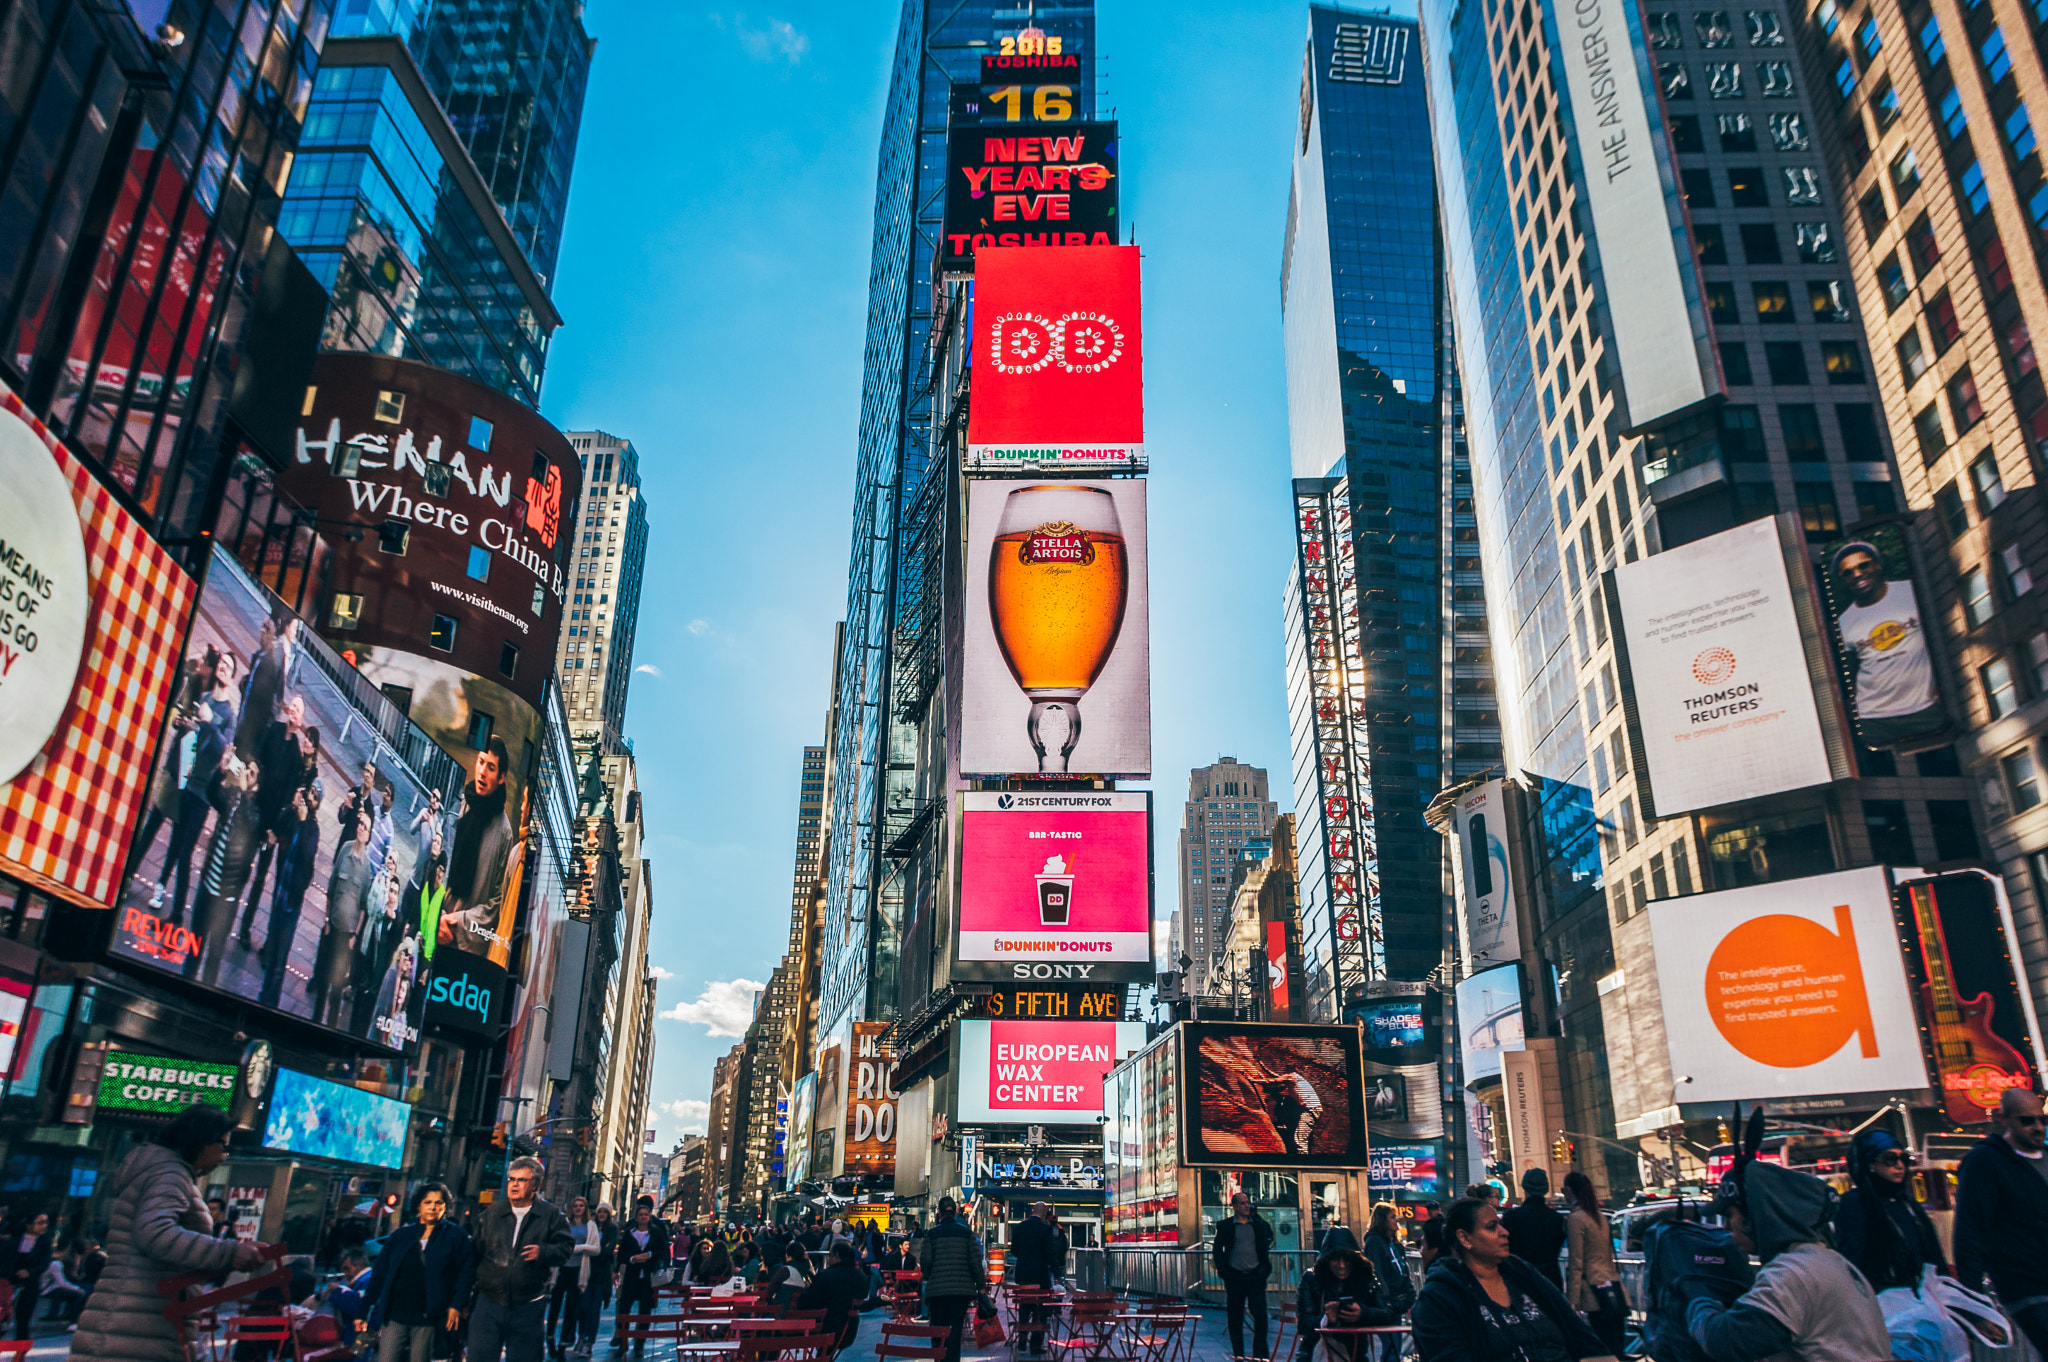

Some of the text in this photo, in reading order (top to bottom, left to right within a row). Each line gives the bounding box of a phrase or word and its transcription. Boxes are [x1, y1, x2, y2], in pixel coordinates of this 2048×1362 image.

[1000, 36, 1063, 56] 2015
[984, 55, 1078, 68] TOSHIBA
[1582, 26, 1623, 128] ANSWER
[966, 103, 979, 114] TH
[988, 84, 1073, 122] 16
[984, 136, 1085, 163] NEW
[1601, 128, 1632, 185] THE
[962, 164, 1110, 190] YEAR'S
[993, 194, 1070, 221] EVE
[948, 232, 1112, 255] TOSHIBA
[346, 479, 469, 536] Where
[480, 518, 549, 583] China
[1032, 548, 1082, 559] ARTOIS
[1033, 538, 1082, 548] STELLA
[0, 538, 54, 600] MEANS
[16, 591, 39, 619] OF
[431, 580, 530, 635] www.visithenan.org
[1648, 618, 1663, 626] The
[14, 624, 39, 652] GO
[1645, 629, 1660, 638] and
[1683, 682, 1759, 710] THOMSON
[1690, 698, 1759, 724] REUTERS
[1305, 509, 1329, 660] ERNST
[1325, 756, 1359, 941] YOUNG
[1675, 733, 1692, 742] the
[1693, 723, 1730, 738] answer
[1017, 798, 1112, 806] 21ST CENTURY FOX
[1464, 793, 1487, 810] RICOH
[1028, 831, 1082, 839] BRR-TASTIC
[1478, 912, 1499, 927] THETA
[122, 907, 203, 957] REVLON
[1060, 941, 1113, 952] DONUTS
[1013, 963, 1094, 979] SONY
[1718, 971, 1738, 981] The
[1720, 973, 1846, 995] technology and human
[1015, 991, 1068, 1016] FIFTH
[1722, 989, 1838, 1009] expertise you need to
[1375, 1013, 1421, 1025] SHADES
[1389, 1021, 1419, 1030] BLUE
[1725, 1013, 1747, 1023] find
[1747, 1008, 1787, 1020] trusted
[997, 1044, 1109, 1062] EUROPEAN
[104, 1062, 234, 1089] STARBUCKS
[996, 1064, 1044, 1082] WAX
[122, 1084, 204, 1105] COFFEE
[1516, 1071, 1532, 1153] THOMSON REUTERS
[772, 1101, 788, 1181] NYGAR
[964, 1137, 973, 1186] NYPD
[1372, 1168, 1412, 1181] BLUE
